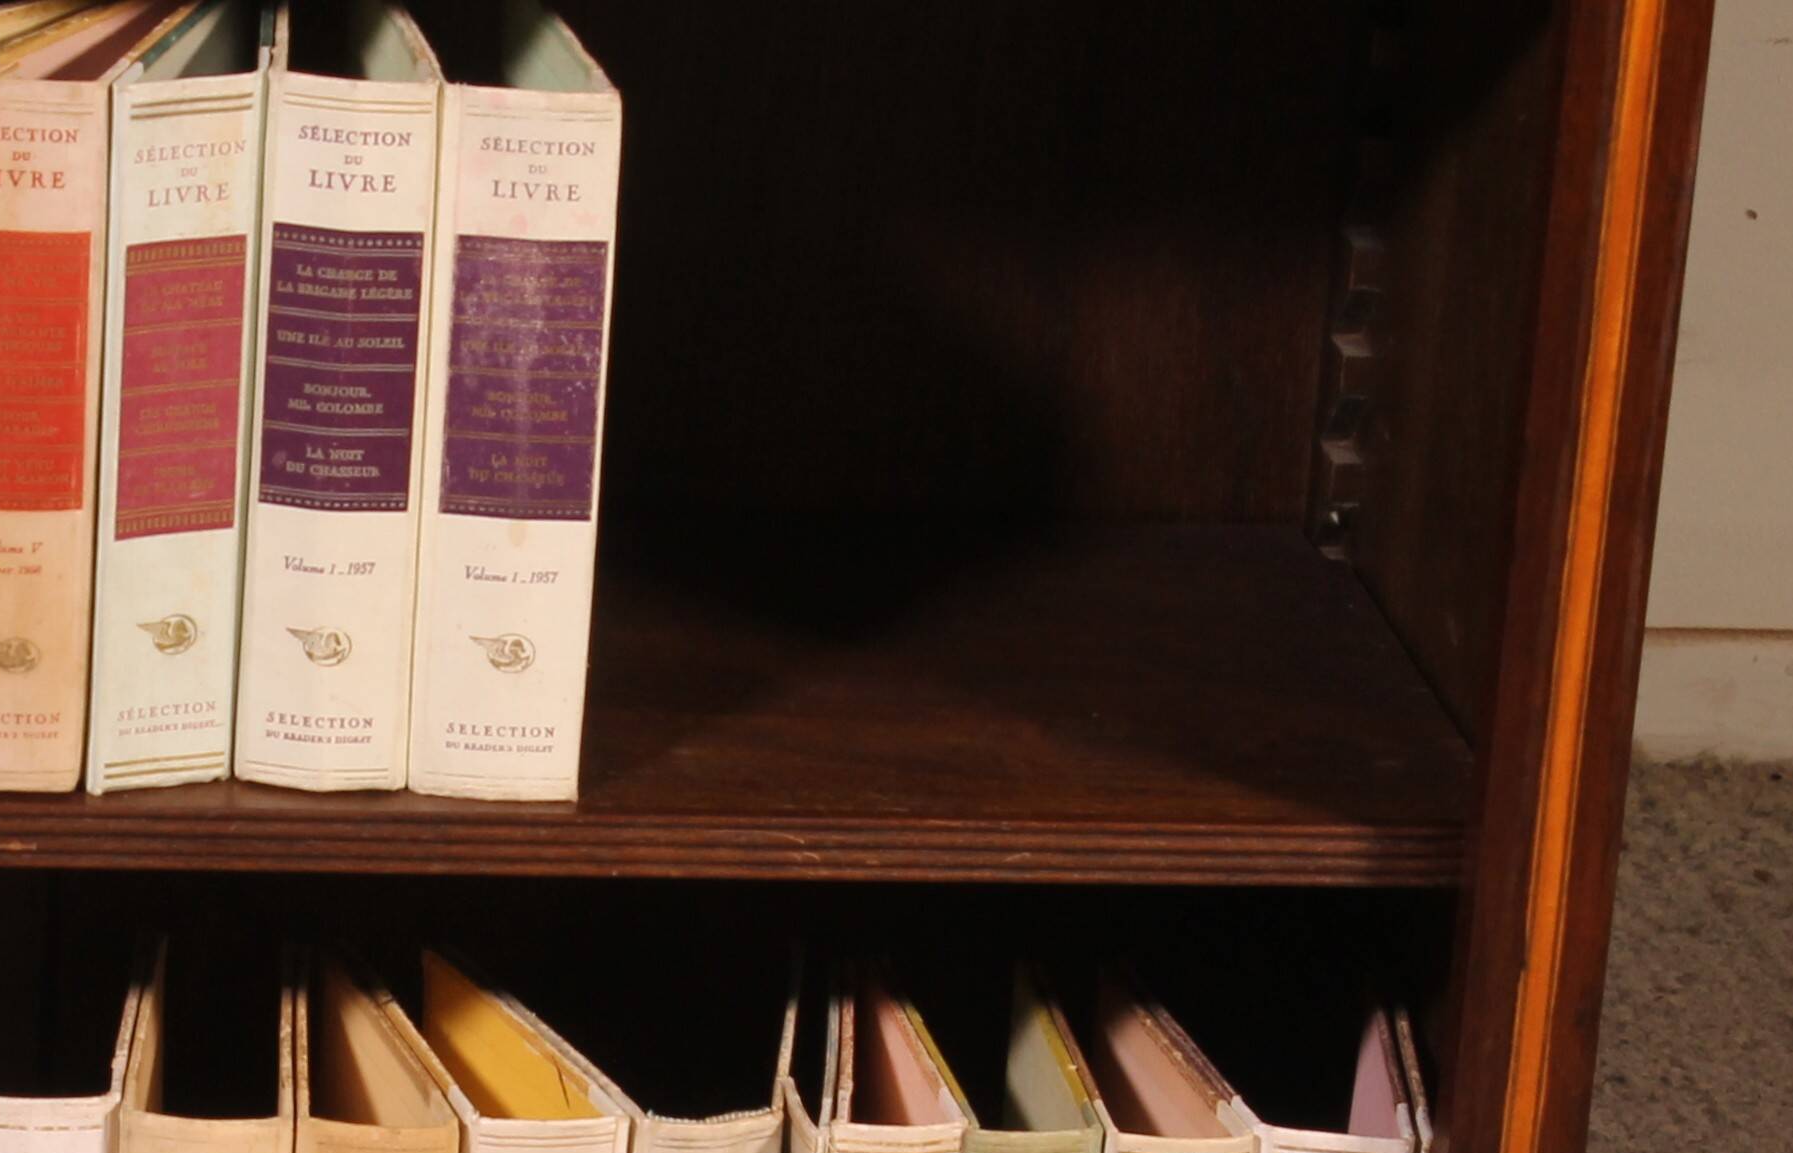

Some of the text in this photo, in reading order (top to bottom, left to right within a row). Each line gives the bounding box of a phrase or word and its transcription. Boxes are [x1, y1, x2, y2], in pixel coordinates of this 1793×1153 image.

[11, 150, 31, 161] DU
[344, 155, 363, 165] DU
[180, 167, 198, 178] DU
[528, 164, 547, 174] DU
[308, 169, 397, 193] LIVRE
[148, 182, 231, 208] LIVRE
[492, 179, 582, 202] LIVRE
[296, 264, 313, 276] LA
[377, 269, 398, 281] DE
[276, 280, 294, 292] LA
[276, 329, 305, 343] UNE
[334, 338, 354, 348] AU
[356, 337, 405, 349] SOLEIL
[305, 446, 325, 460] LA
[286, 461, 381, 478] DU CHASSEUR
[283, 555, 325, 575] Volume
[347, 562, 376, 576] 1957
[464, 565, 507, 583] Volume
[529, 571, 559, 584] 1957
